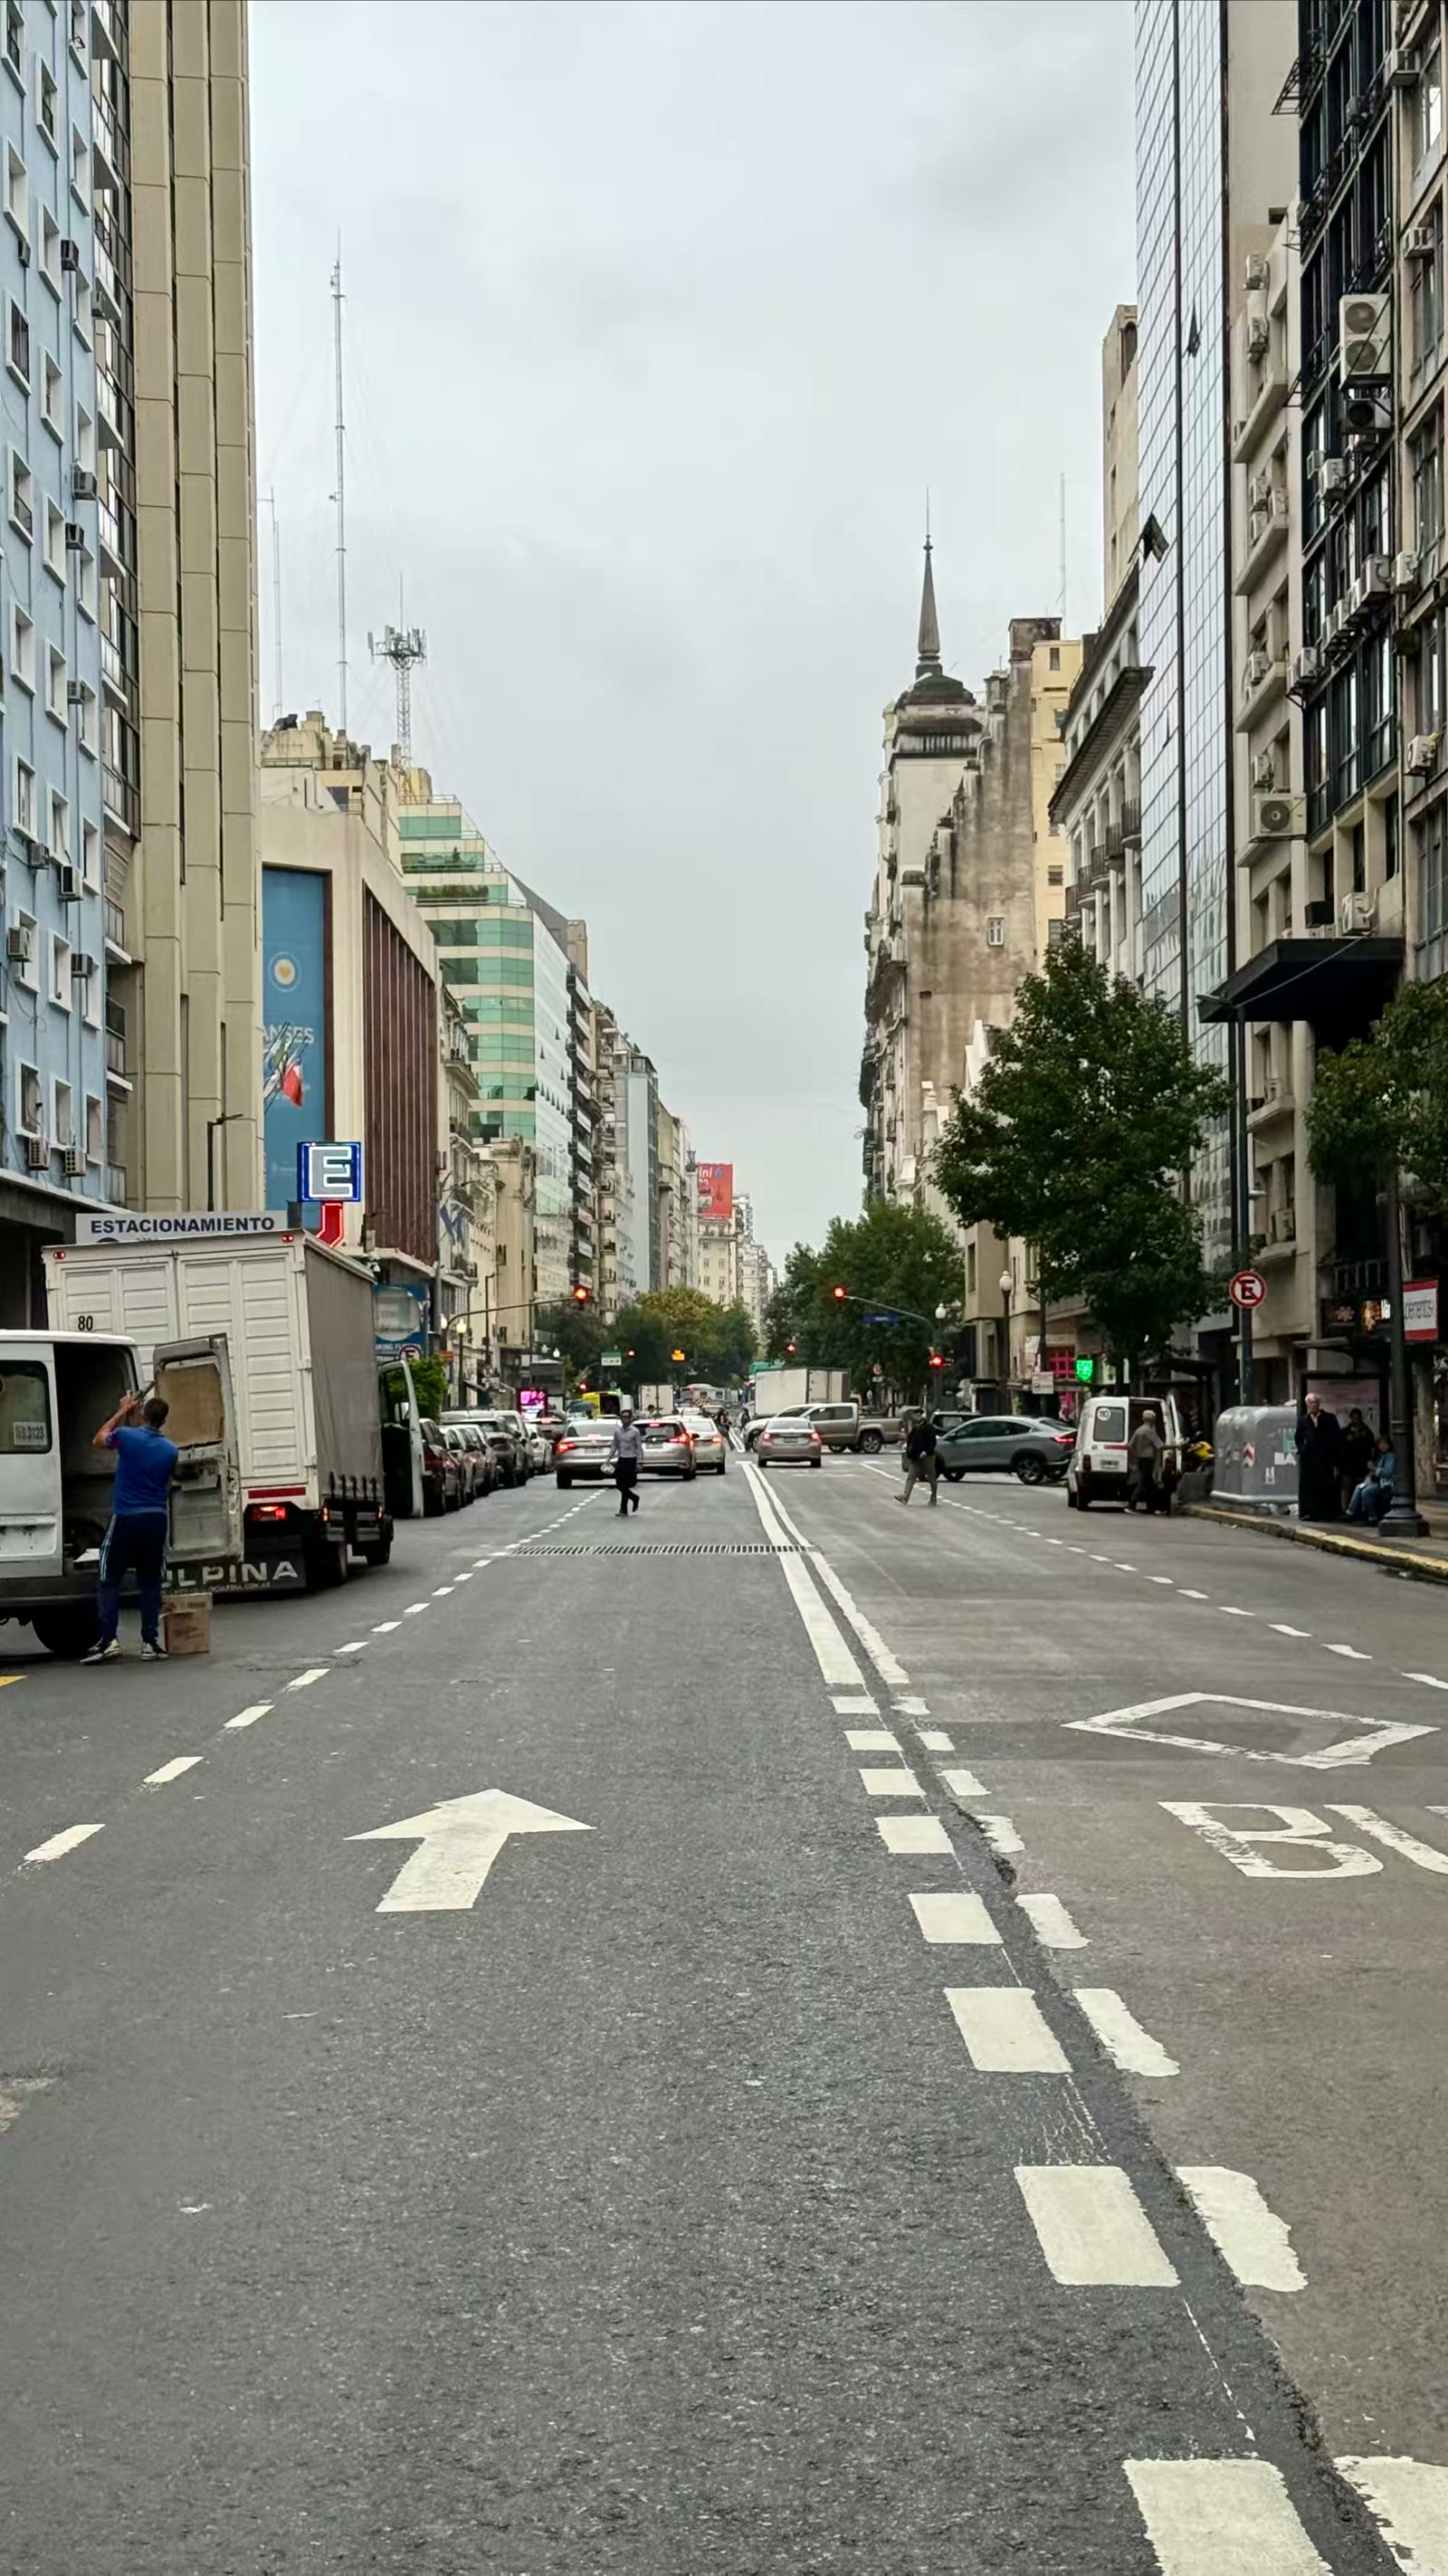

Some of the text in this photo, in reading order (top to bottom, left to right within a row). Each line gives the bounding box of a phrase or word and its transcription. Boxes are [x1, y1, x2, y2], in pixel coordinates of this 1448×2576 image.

[309, 1146, 354, 1198] E
[90, 1216, 275, 1234] ESTACIONAMIENTO
[78, 1315, 94, 1331] 80
